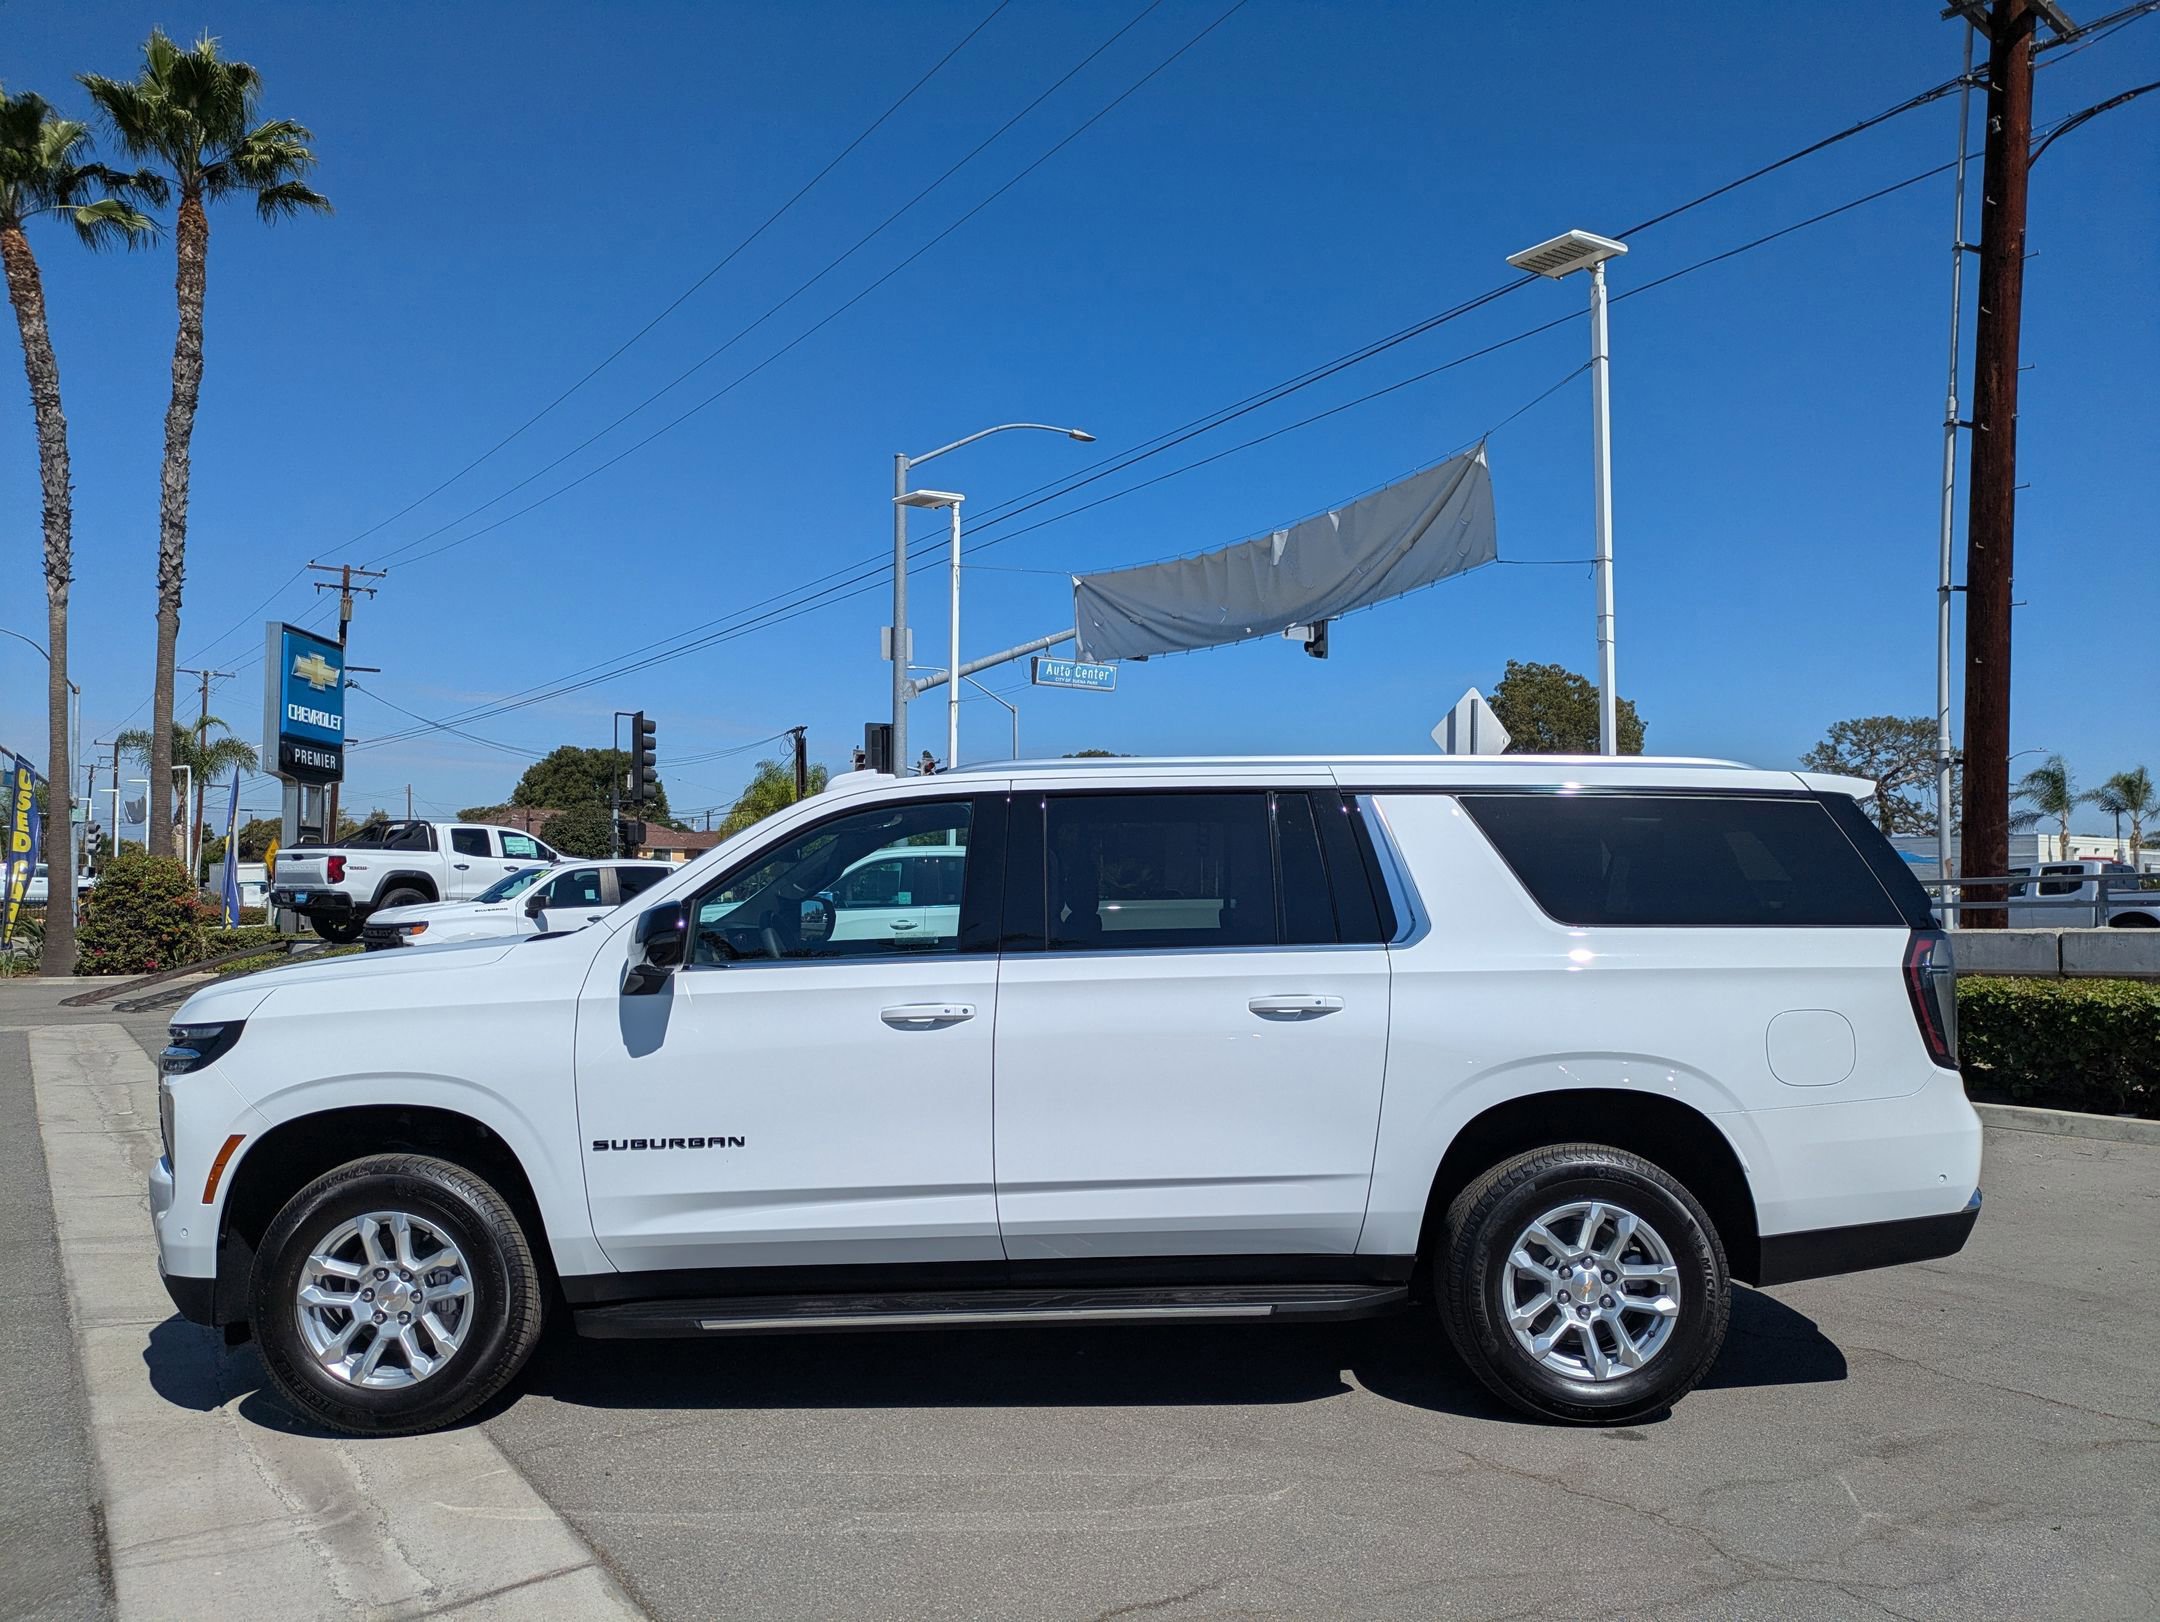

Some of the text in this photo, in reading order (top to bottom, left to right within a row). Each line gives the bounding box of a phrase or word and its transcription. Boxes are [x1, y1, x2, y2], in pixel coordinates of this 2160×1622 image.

[1046, 663, 1109, 680] Auto Center
[288, 703, 342, 731] CHEVROLET
[294, 748, 336, 769] PREMIER
[12, 767, 33, 853] USED
[592, 1136, 745, 1151] SUBURBAN
